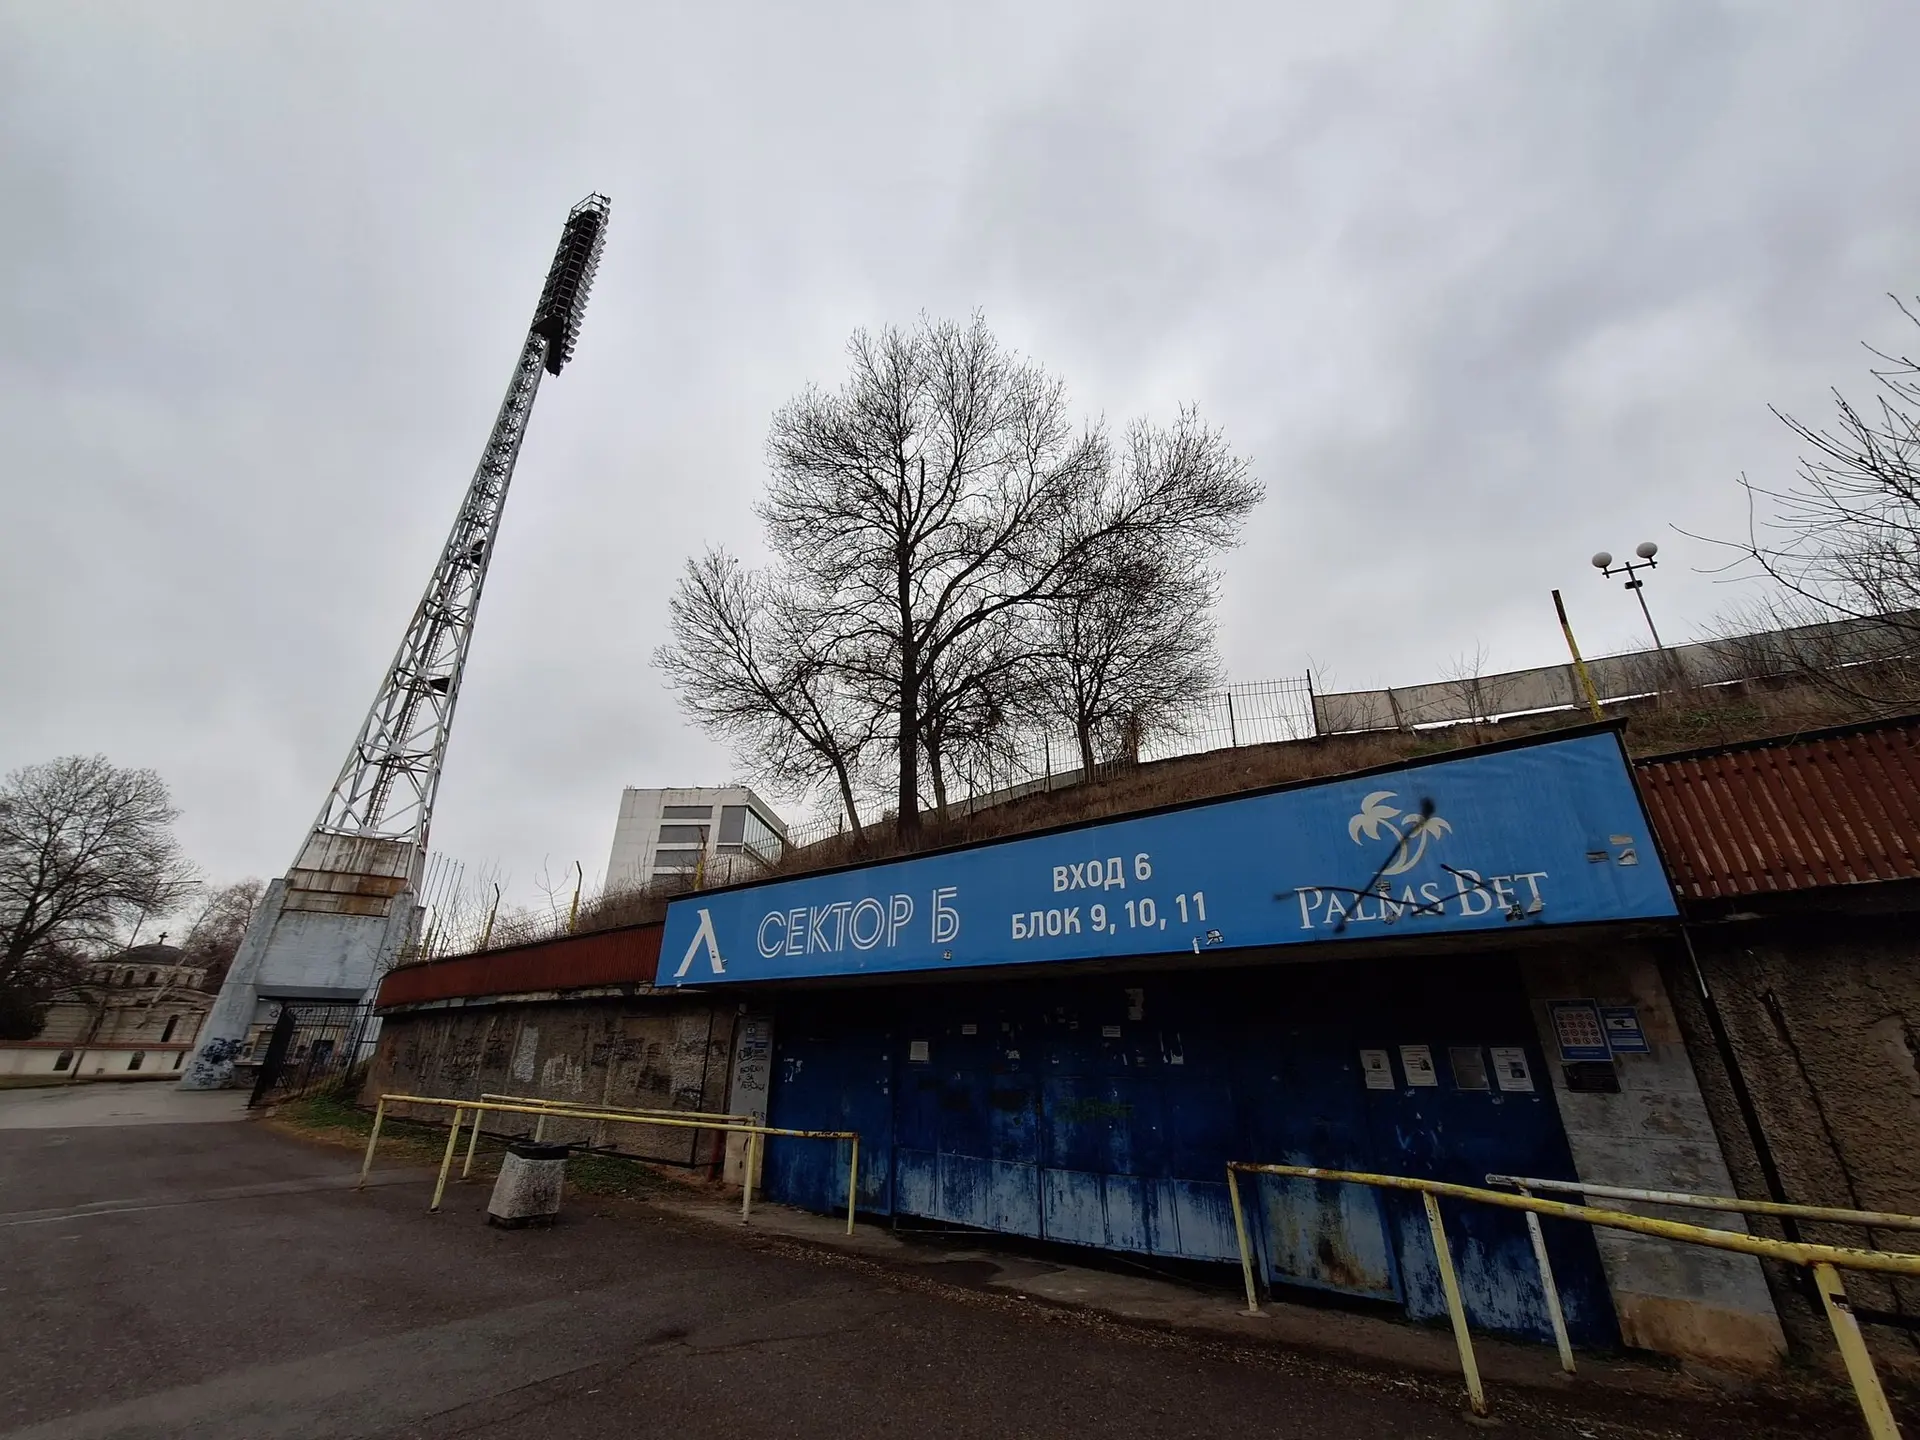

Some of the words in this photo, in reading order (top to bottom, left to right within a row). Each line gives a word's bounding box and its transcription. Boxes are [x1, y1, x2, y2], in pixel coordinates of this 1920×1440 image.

[1053, 857, 1126, 892] ВХОД
[1134, 852, 1152, 881] 6
[1293, 882, 1445, 930] PALMS
[1448, 869, 1549, 919] BET
[757, 894, 914, 959] СЕКТОР
[931, 886, 960, 944] Б
[1012, 907, 1081, 940] БЛОК
[1090, 904, 1116, 935] 9,
[1124, 898, 1167, 931] 10,
[1175, 891, 1206, 924] 11
